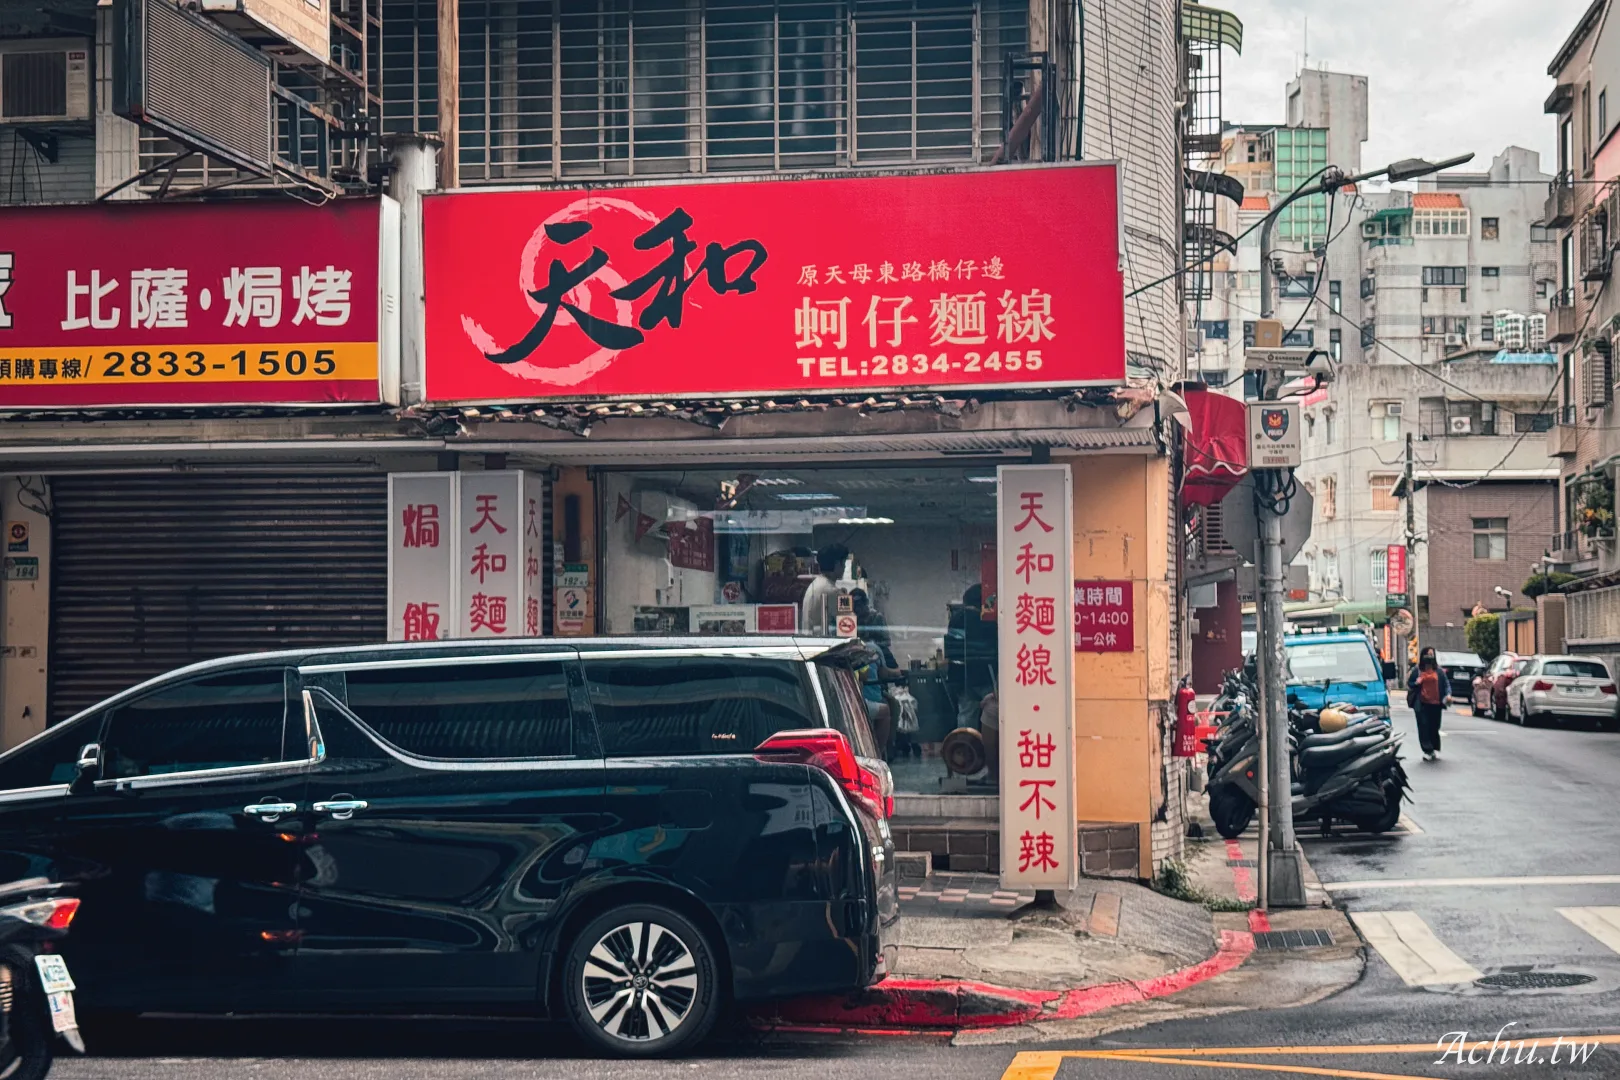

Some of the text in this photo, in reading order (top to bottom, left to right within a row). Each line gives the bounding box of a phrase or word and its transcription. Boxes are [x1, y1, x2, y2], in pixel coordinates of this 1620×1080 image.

[484, 207, 768, 364] 天和
[796, 255, 1005, 287] 原天母東路橋仔邊
[794, 288, 1056, 349] 蚵仔麵線
[103, 350, 336, 377] 2833-1505
[797, 350, 1043, 377] TEL:2834-2455
[470, 495, 507, 633] 天和麵
